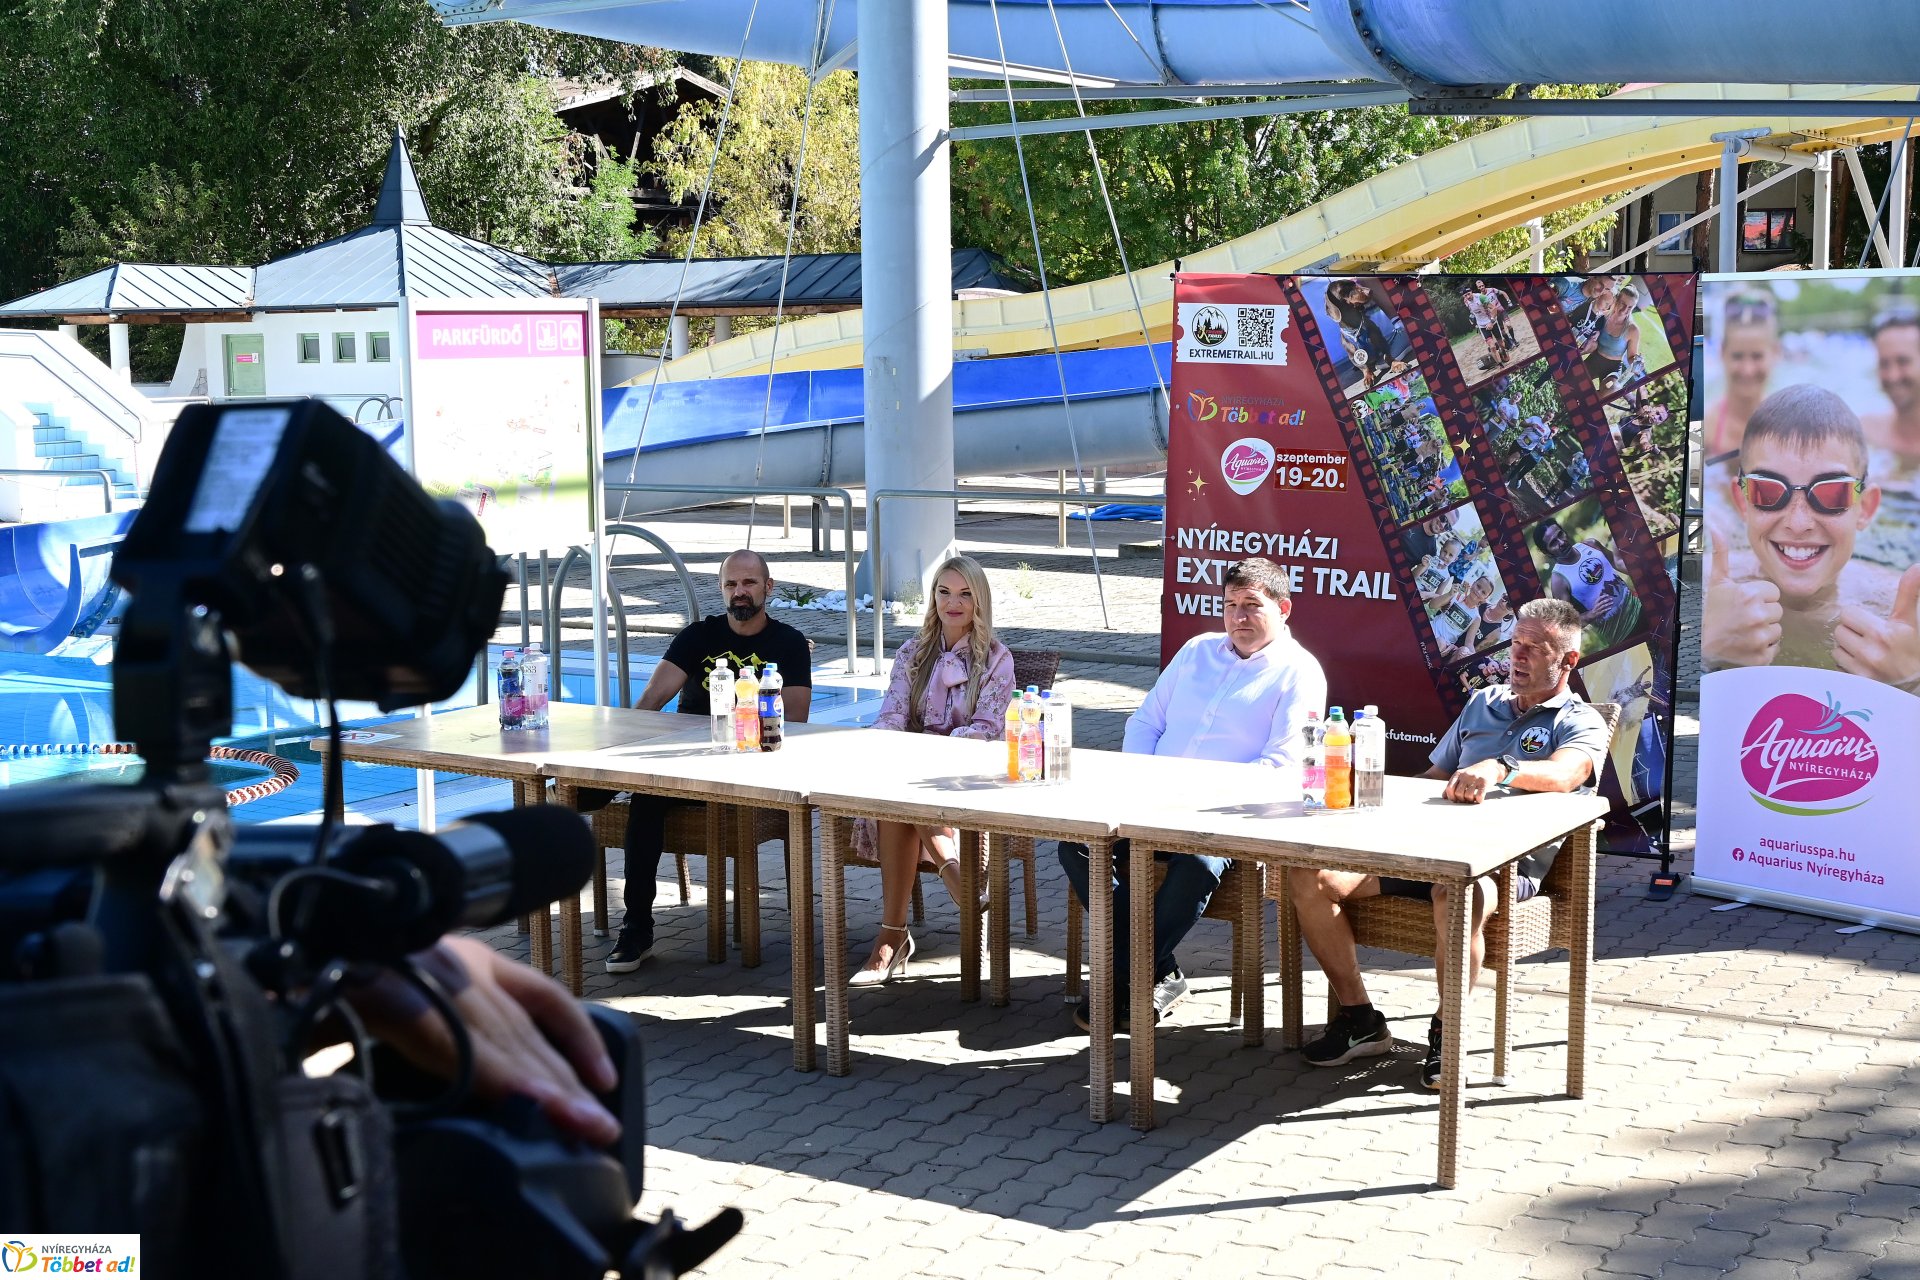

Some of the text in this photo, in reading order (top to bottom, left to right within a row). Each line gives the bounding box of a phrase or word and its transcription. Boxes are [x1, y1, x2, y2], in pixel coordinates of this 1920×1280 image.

[432, 323, 523, 346] PARKFÜRDŐ
[1189, 347, 1274, 361] EXTREMETRAIL.HU
[1221, 406, 1306, 426] Többet ad!
[1225, 453, 1268, 480] Aquarius
[1276, 452, 1347, 465] szeptember
[1276, 466, 1346, 489] 19-20.
[1176, 522, 1339, 560] NYÍREGYHÁZI
[1312, 567, 1397, 601] TRAIL
[1740, 717, 1878, 797] Aquarius
[1788, 761, 1873, 781] NYÍREGYHÁZA
[1759, 835, 1855, 862] aquariusspa.hu
[1748, 850, 1885, 886] Aquarius Nyíregyháza
